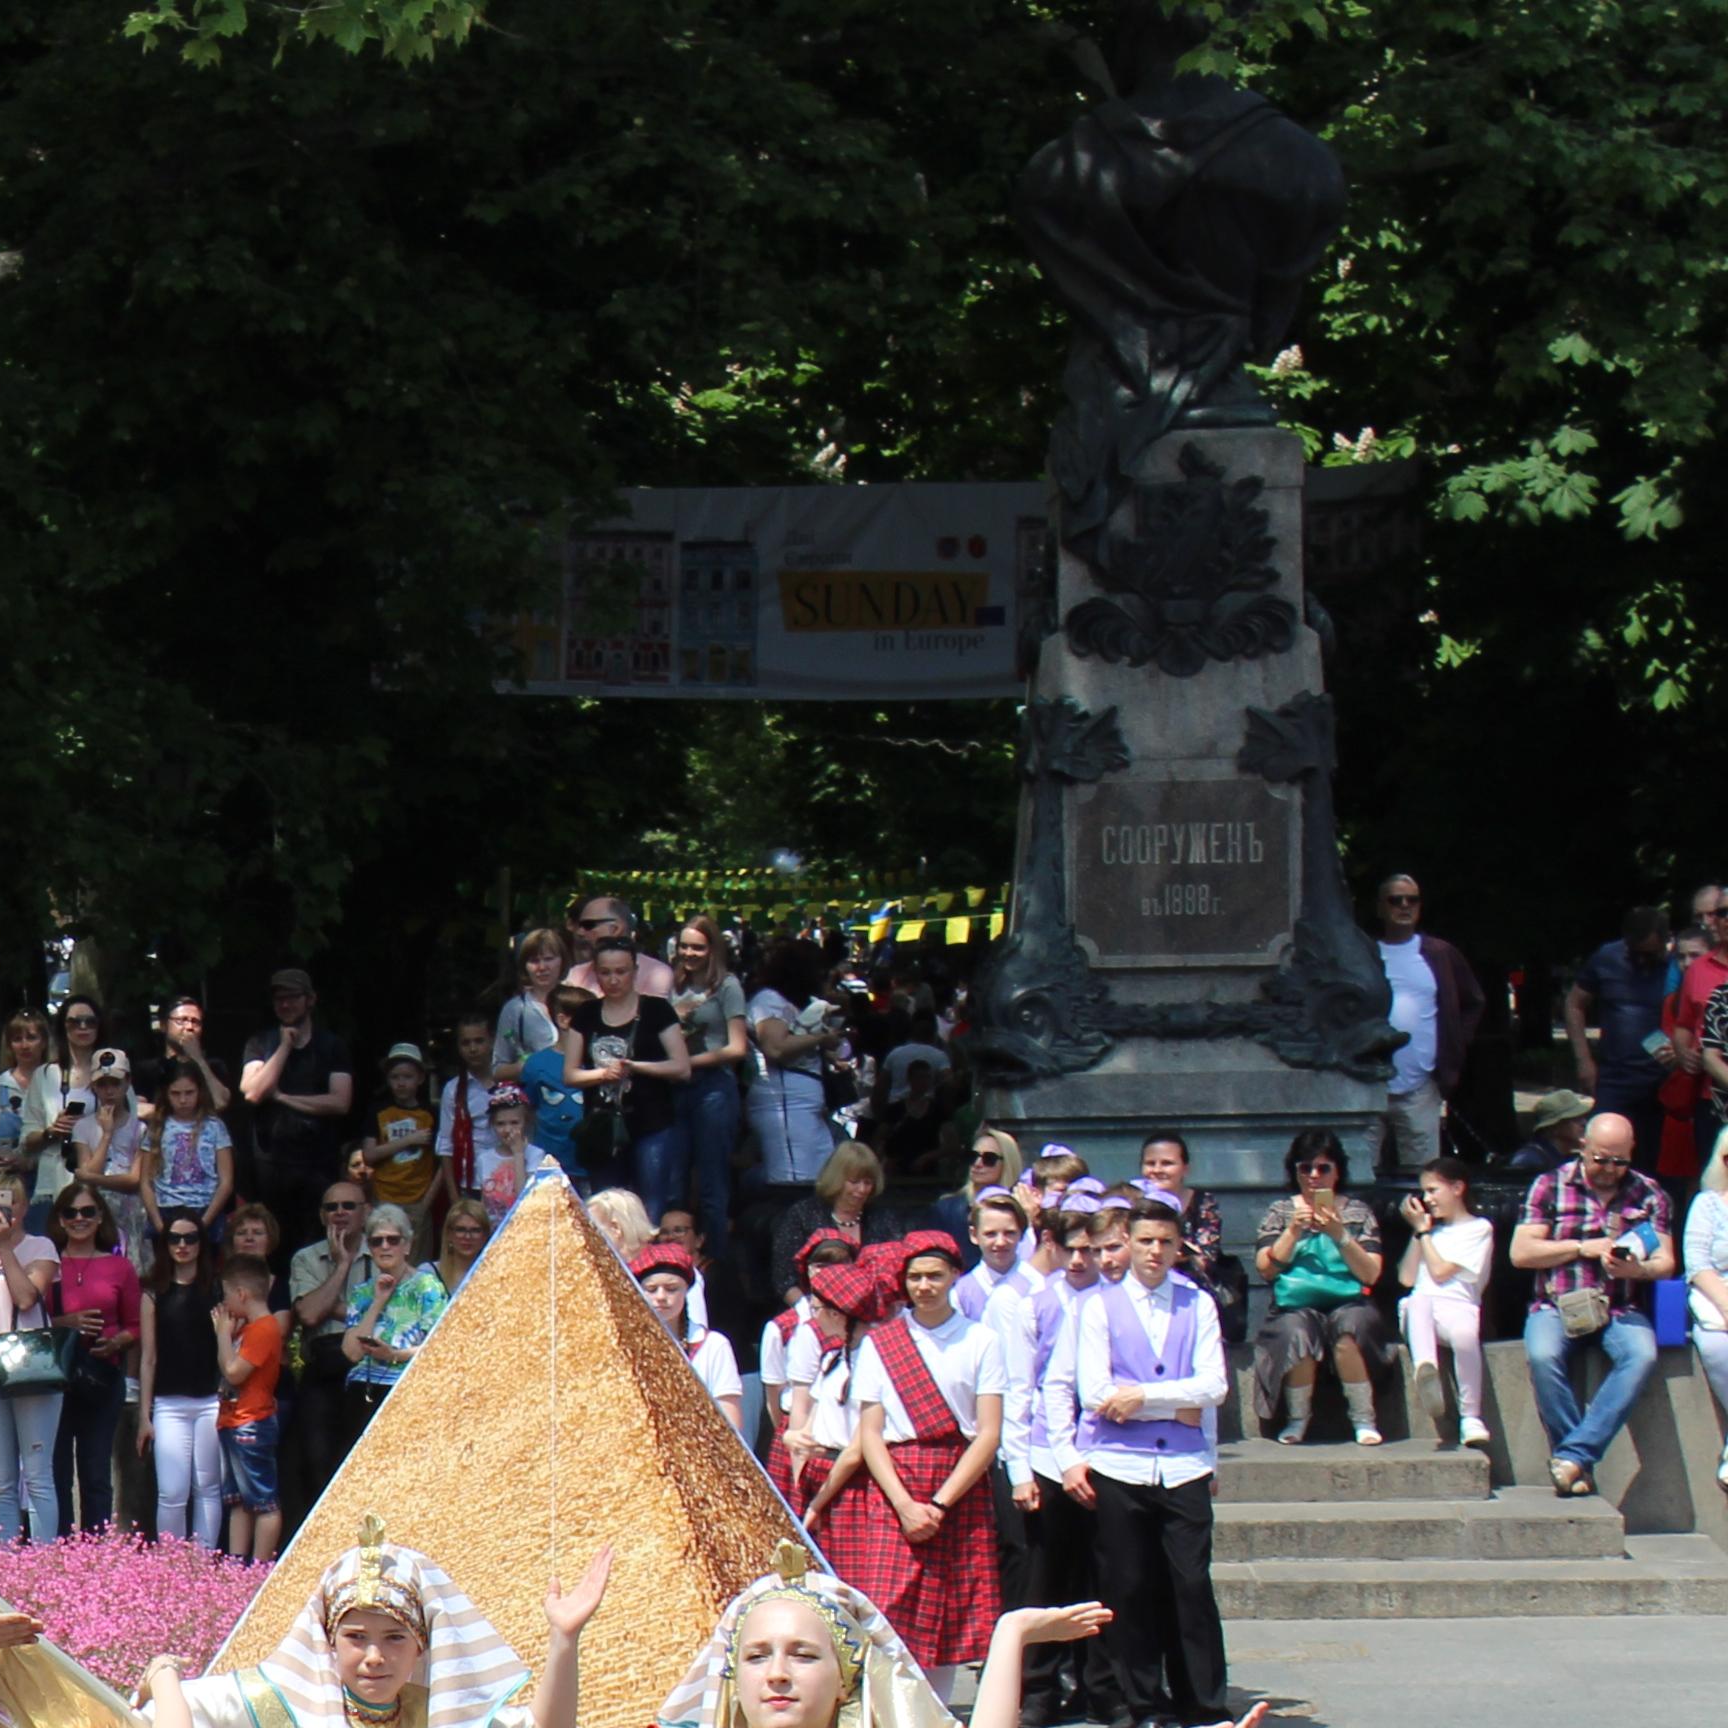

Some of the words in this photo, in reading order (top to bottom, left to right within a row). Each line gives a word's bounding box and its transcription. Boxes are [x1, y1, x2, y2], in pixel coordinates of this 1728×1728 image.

[792, 579, 981, 628] SUNDAY
[874, 632, 895, 651] in
[905, 630, 985, 657] Europe
[1101, 822, 1264, 865] СООРУЖЕНЪ
